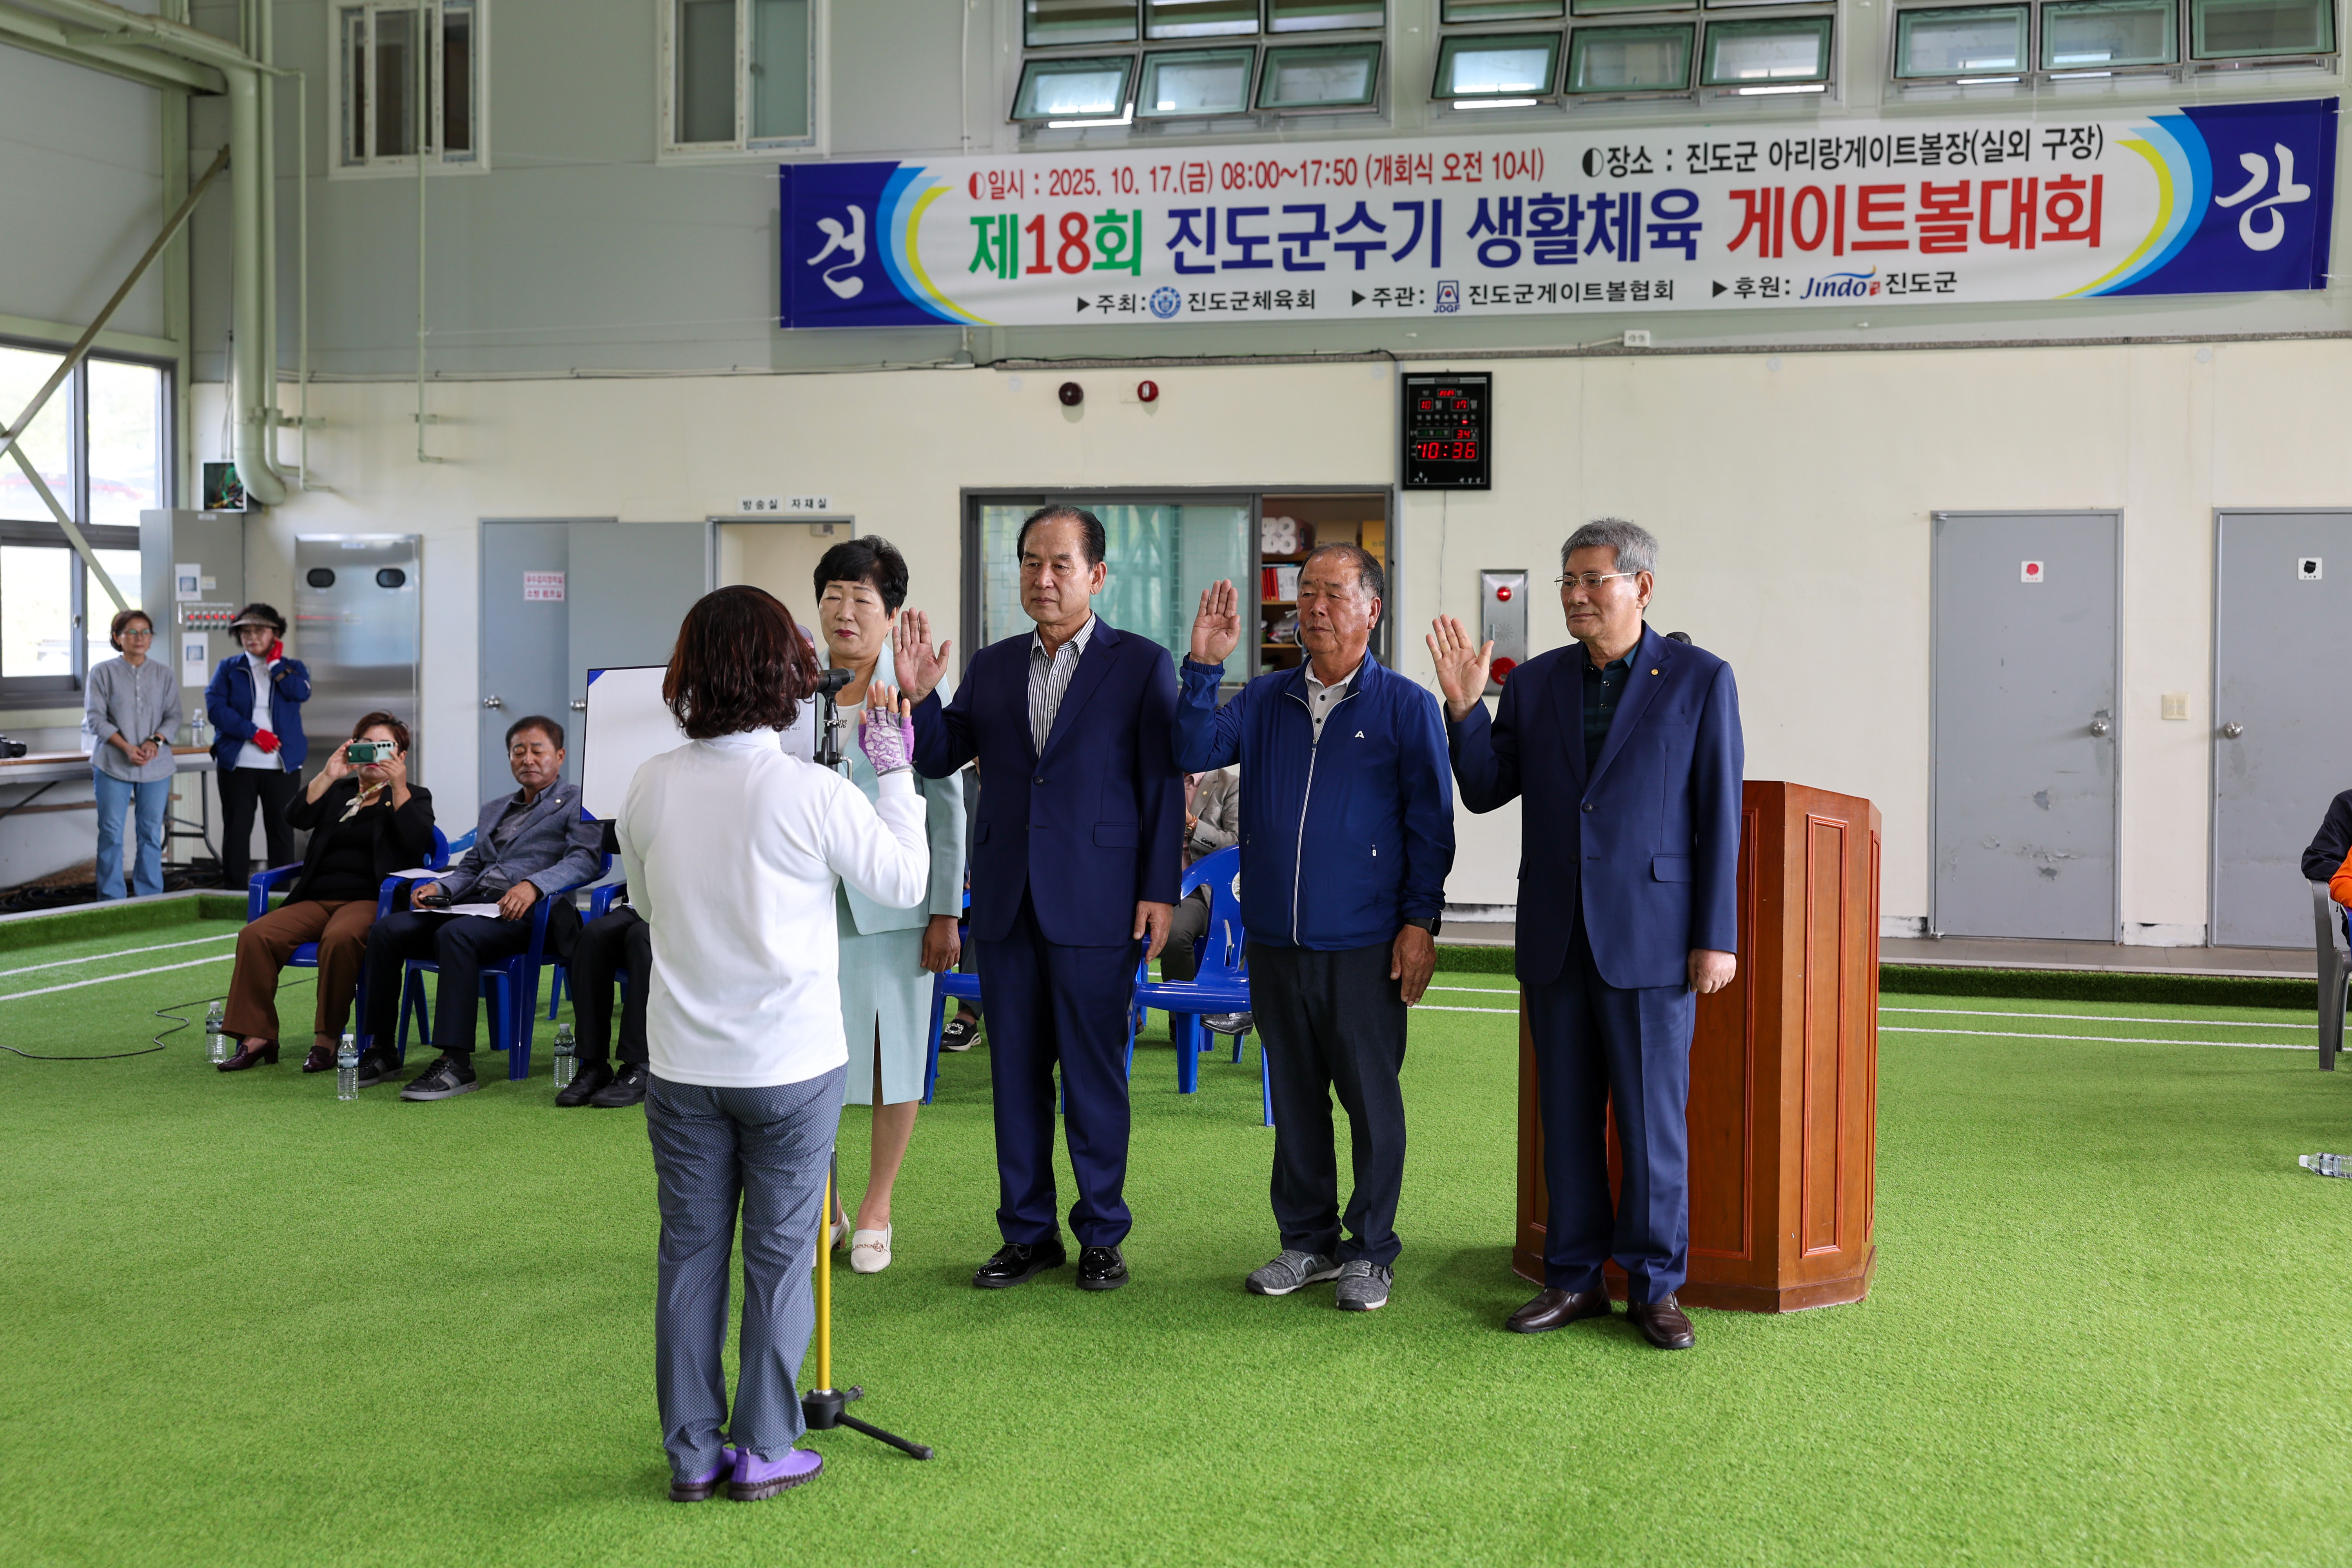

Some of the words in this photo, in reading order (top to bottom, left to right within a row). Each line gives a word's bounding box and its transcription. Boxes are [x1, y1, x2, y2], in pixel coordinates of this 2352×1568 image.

[1606, 145, 1654, 178] 장소
[1686, 141, 1759, 175] 진도군
[1768, 128, 2031, 172] 아리랑게이트볼장(실외
[2042, 123, 2104, 161] 구장)
[988, 169, 1024, 200] 일시
[1049, 168, 1101, 196] 2025.
[1111, 166, 1140, 195] 10.
[1221, 157, 1358, 191] 08:00~17:50
[1365, 152, 1433, 188] (개회식
[1441, 151, 1482, 183] 오전
[1492, 147, 1544, 182] 10시)
[2214, 142, 2311, 251] 강
[968, 208, 1143, 280] 제18회
[1165, 198, 1443, 275] 진도군수기
[1466, 188, 1703, 269] 생활체육
[1726, 173, 2103, 259] 게이트볼대회
[807, 205, 866, 299] 건
[1468, 279, 1674, 305] 진도군게이트볼협회
[1733, 276, 1790, 299] 후원:
[1886, 271, 1957, 295] 진도군
[1096, 294, 1146, 314] 주최:
[1187, 289, 1315, 312] 진도군체육회
[1371, 286, 1425, 308] 주관:
[1433, 305, 1461, 313] JDGF
[1421, 400, 1432, 409] 10
[1456, 399, 1467, 409] 17
[1457, 430, 1470, 439] 34
[1421, 442, 1475, 459] 10:36
[742, 499, 778, 510] 방송실
